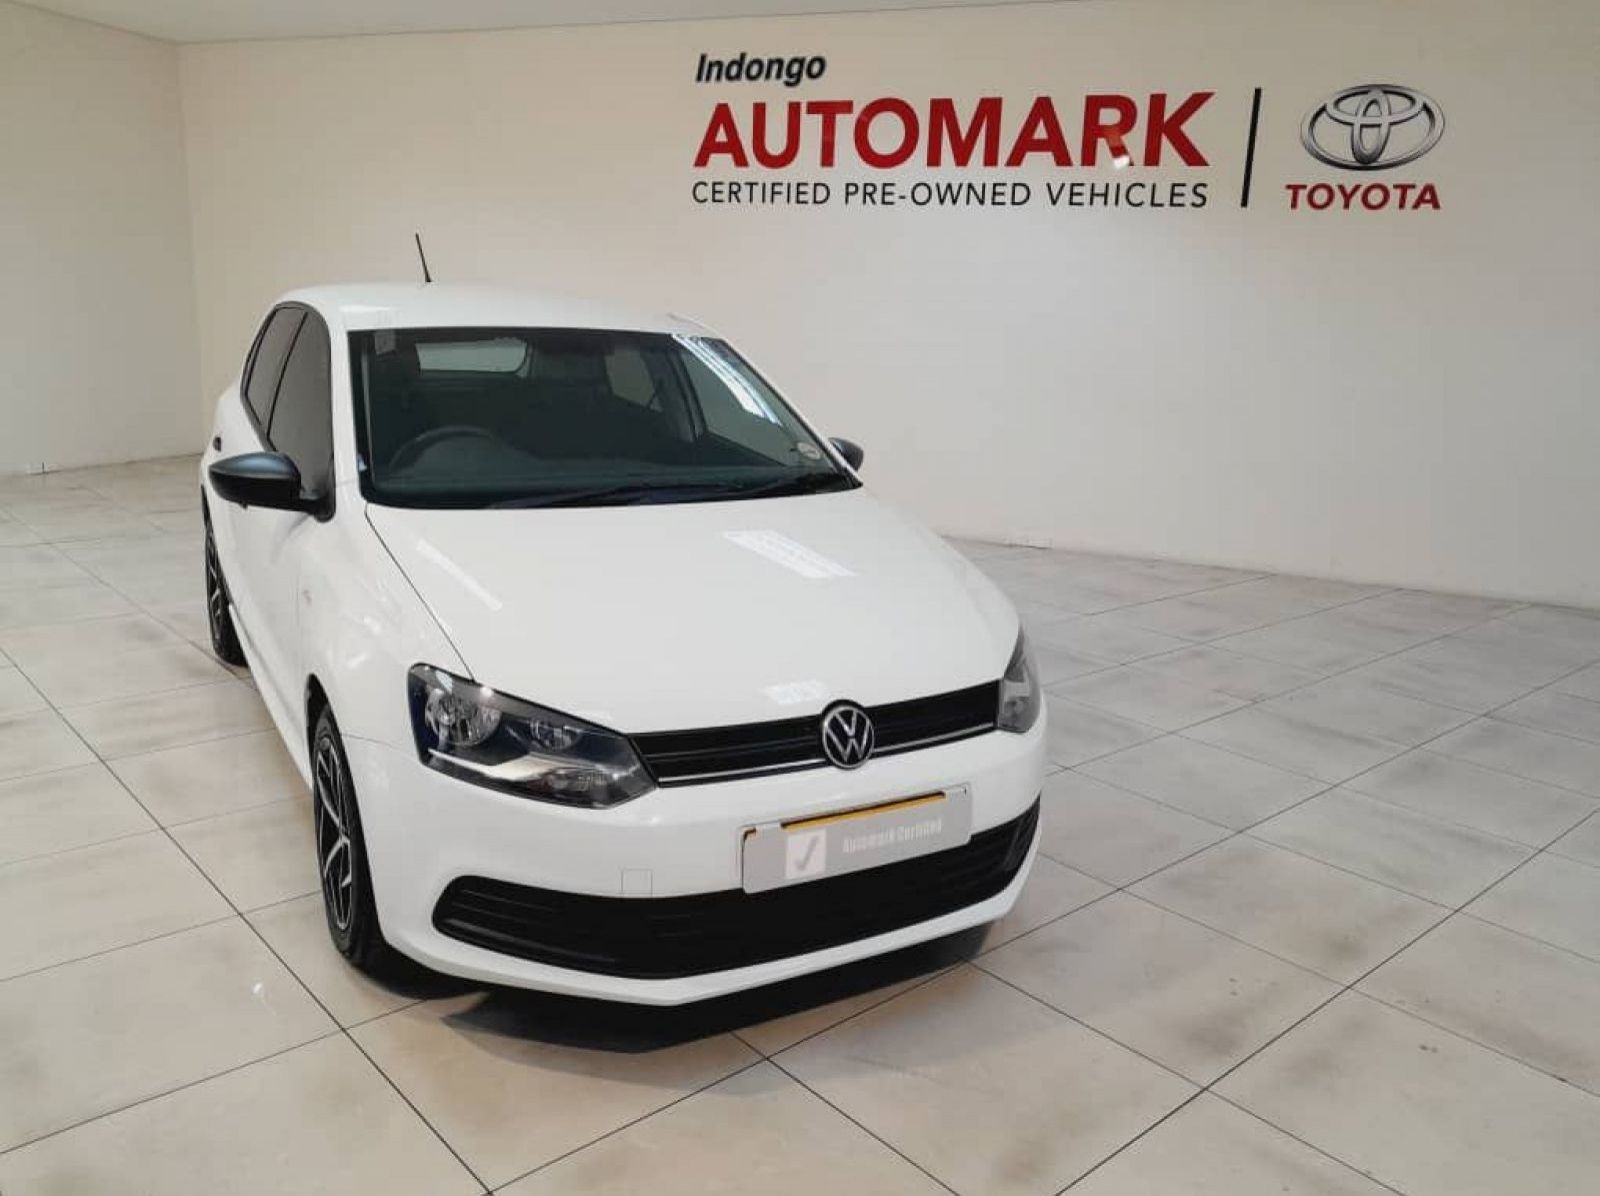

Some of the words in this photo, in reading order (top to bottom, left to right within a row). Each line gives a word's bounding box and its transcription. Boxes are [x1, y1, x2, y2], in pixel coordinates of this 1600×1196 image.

[695, 52, 827, 88] Indongo
[693, 91, 1215, 170] AUTOMARK
[691, 181, 832, 205] CERTIFIED
[844, 181, 1032, 207] PRE-OWNED
[1046, 182, 1209, 209] VEHICLES
[1285, 183, 1441, 210] TOYOTA
